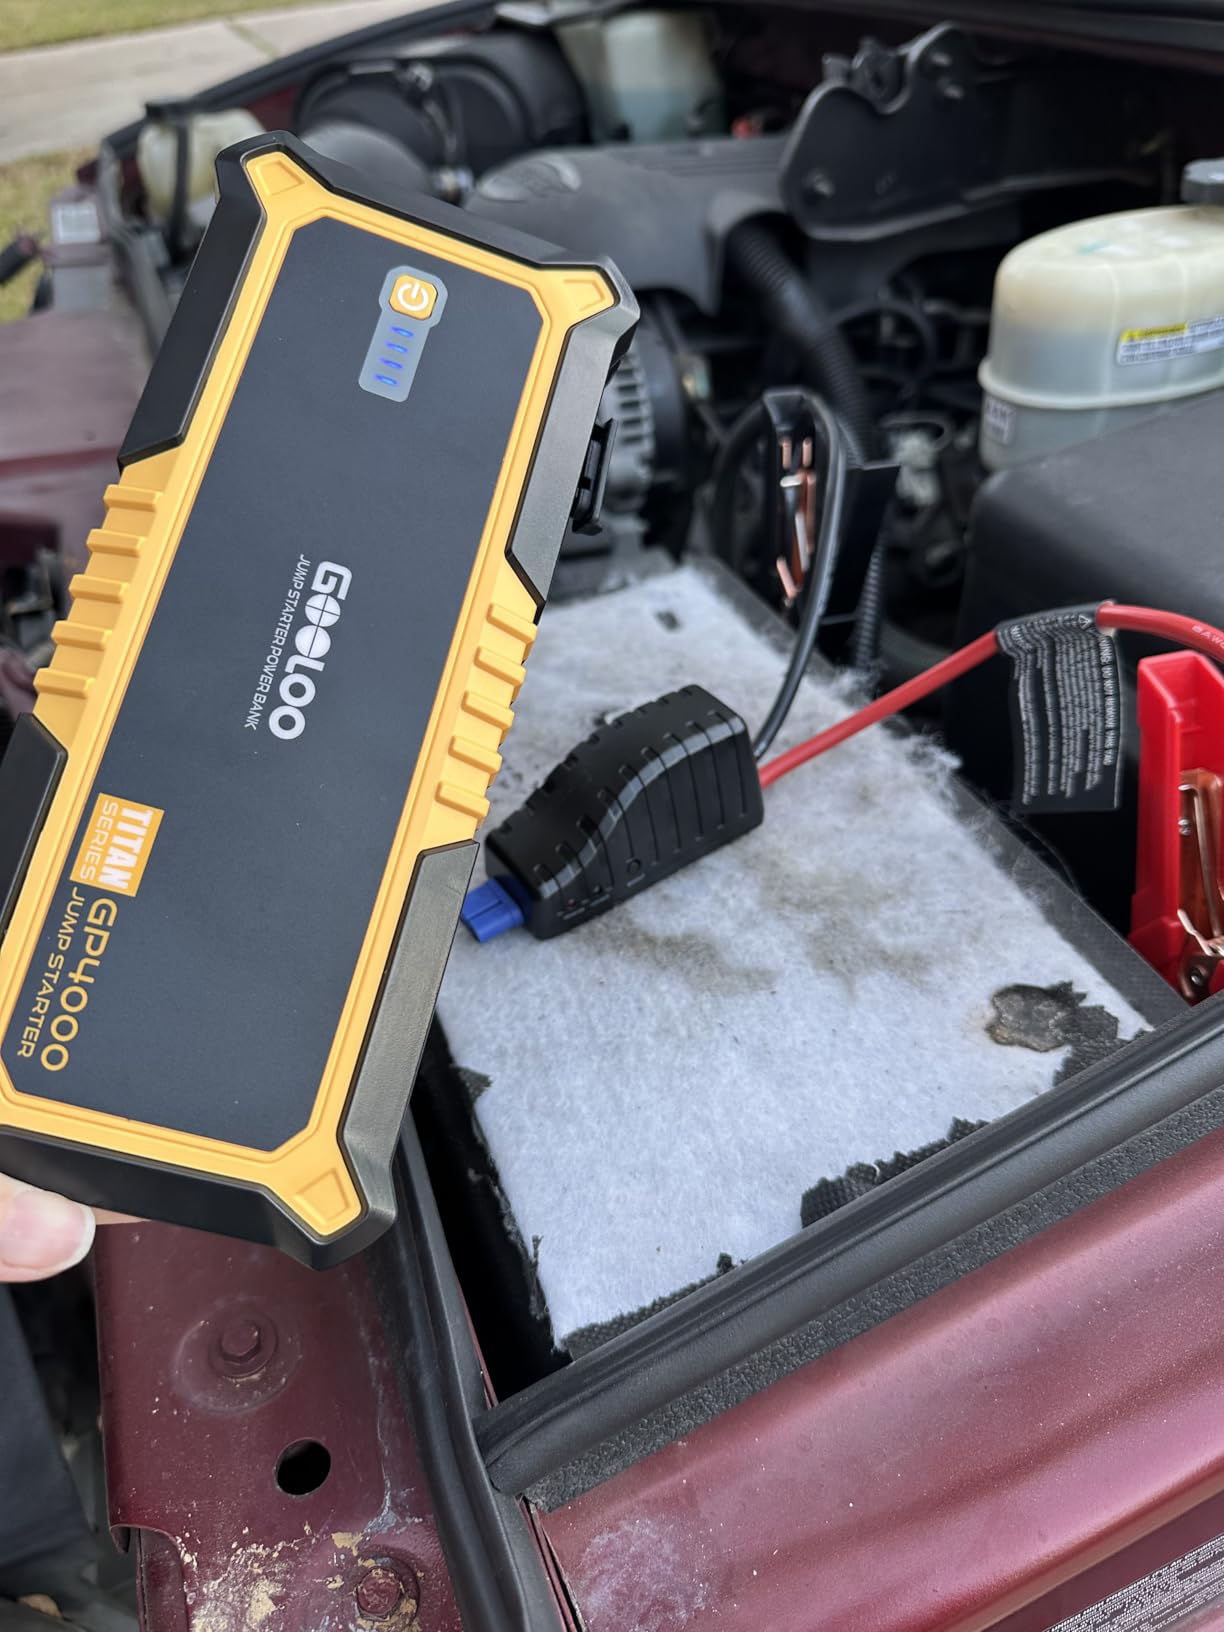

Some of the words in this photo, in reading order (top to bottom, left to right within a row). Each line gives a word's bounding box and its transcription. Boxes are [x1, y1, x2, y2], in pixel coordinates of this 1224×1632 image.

[293, 554, 311, 590] JUMP
[268, 561, 352, 740] GOOLOO
[272, 589, 301, 647] STARTER
[256, 645, 283, 693] POWER
[244, 692, 267, 731] BANK
[79, 800, 118, 881] SERIES
[98, 808, 153, 890] TITAN
[57, 886, 85, 951] JUMP
[17, 953, 65, 1058] STARTER
[40, 898, 118, 1072] GP4000
